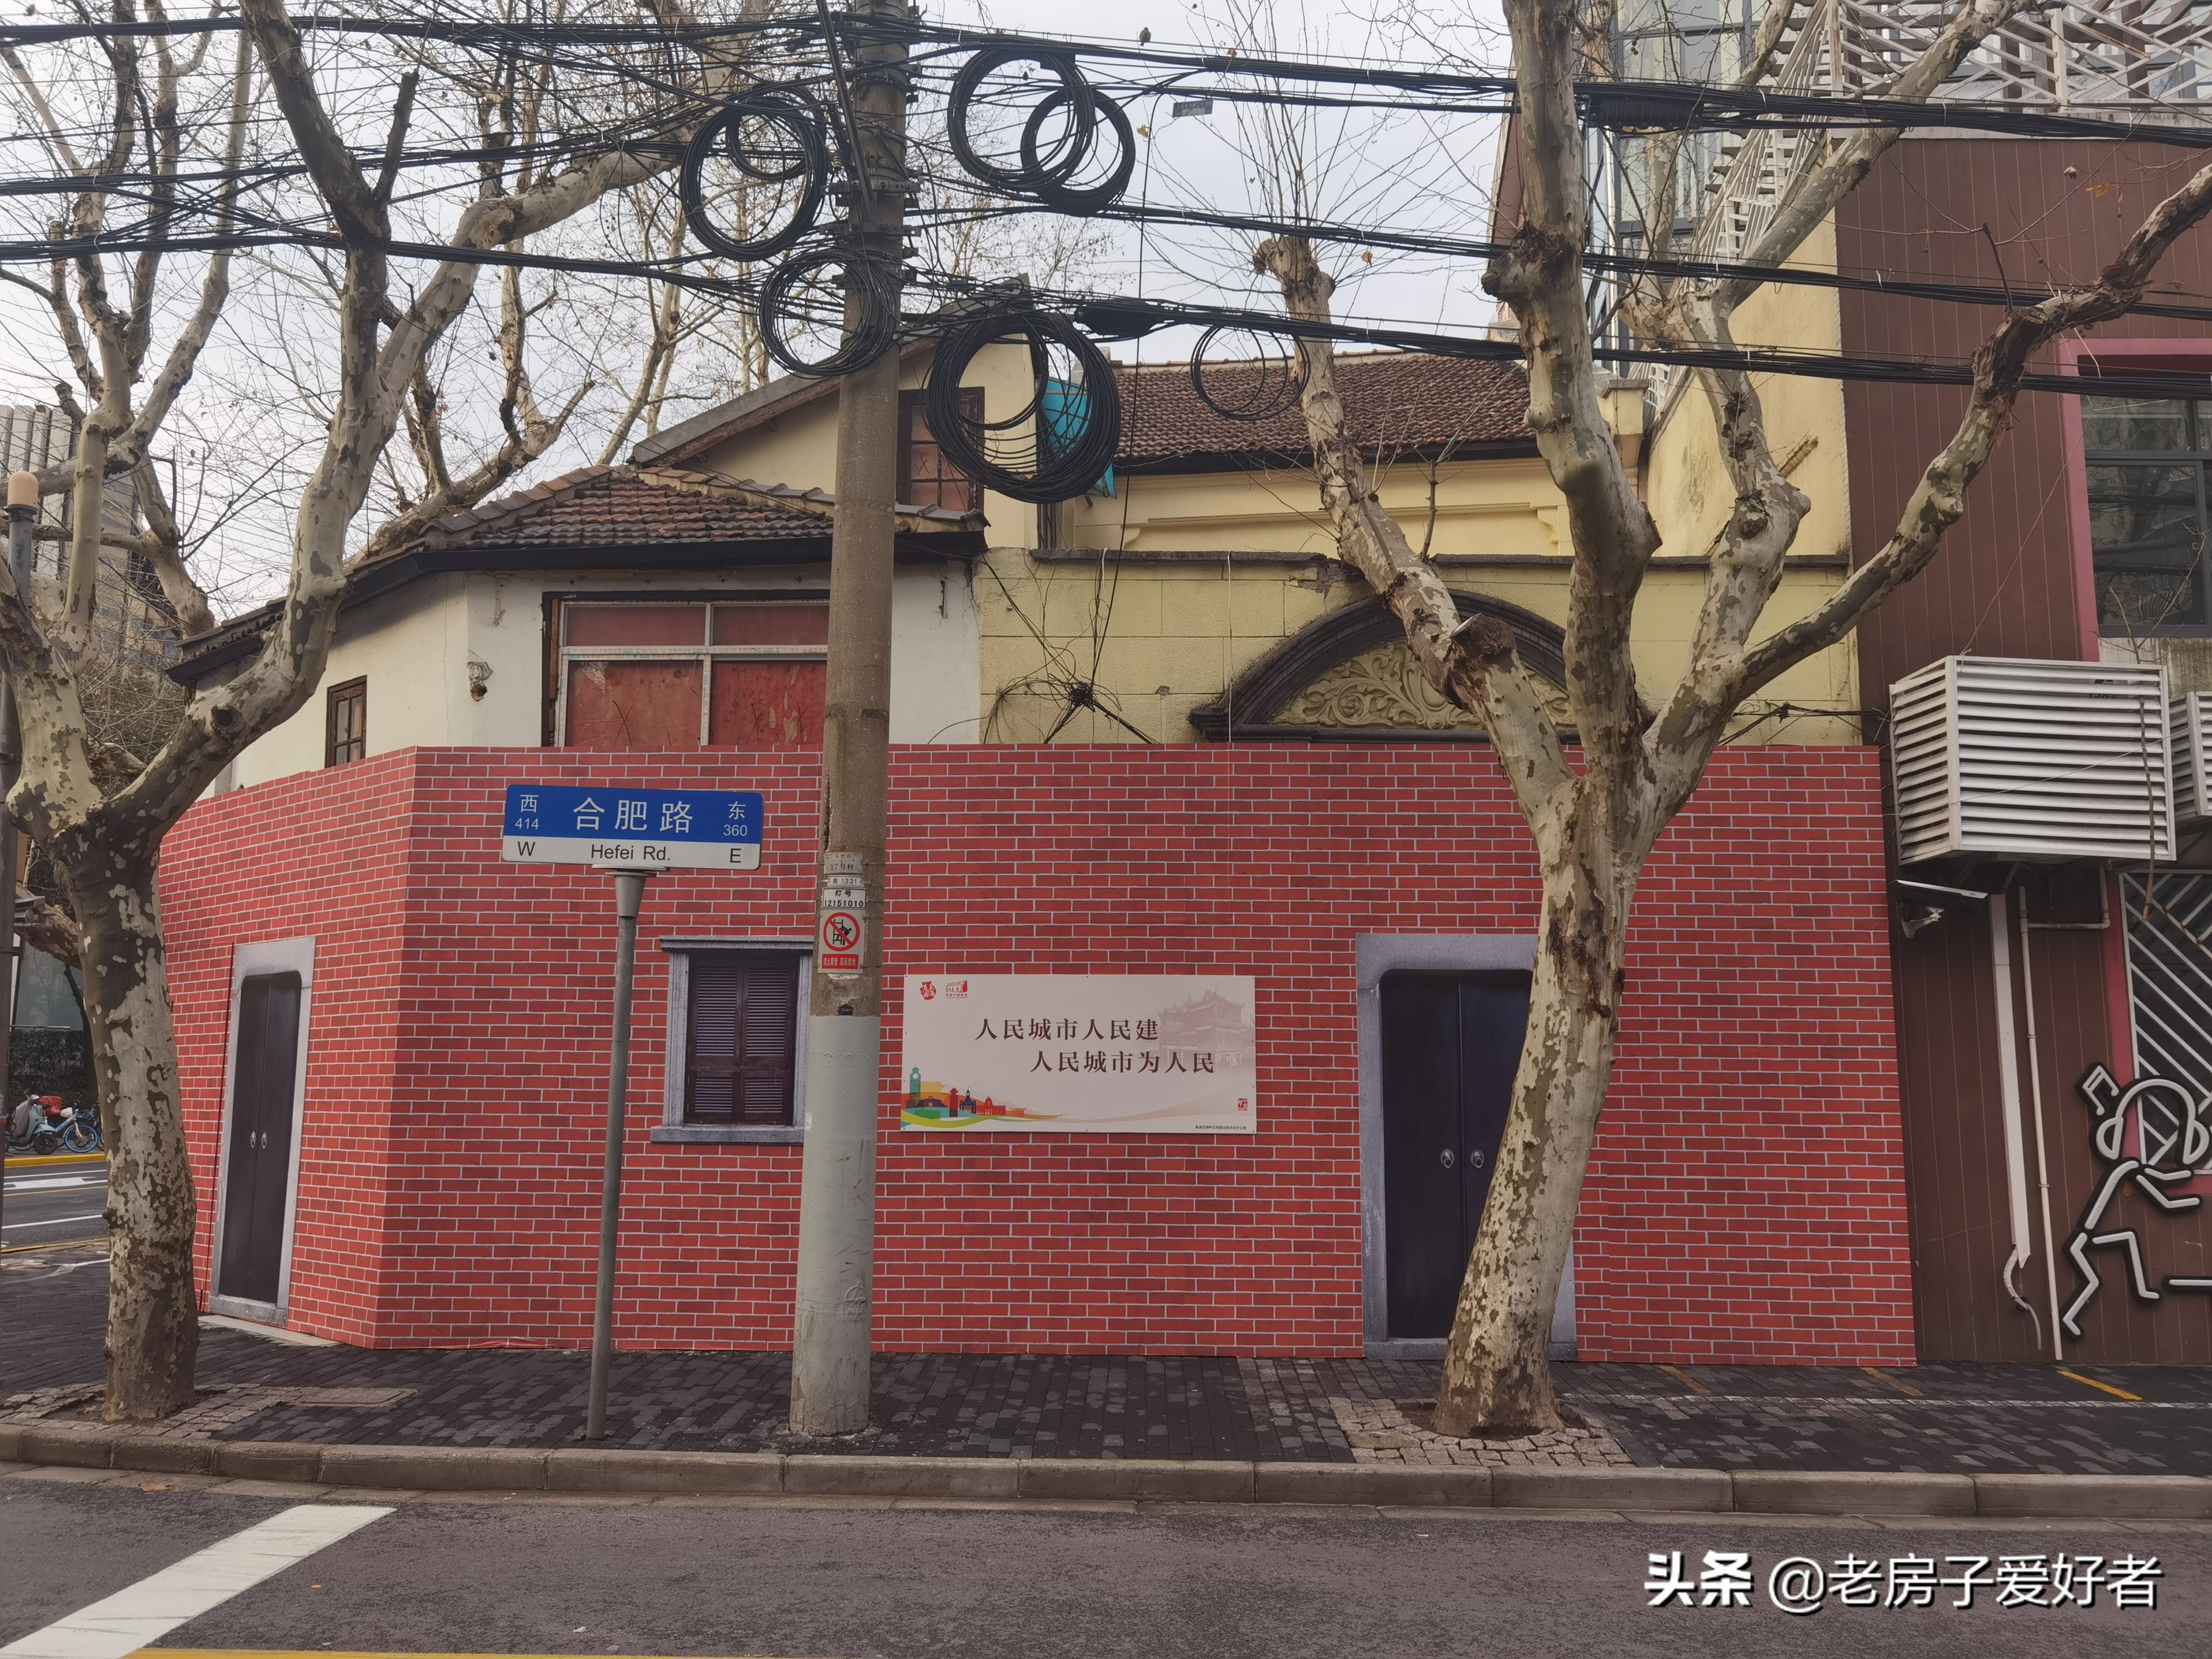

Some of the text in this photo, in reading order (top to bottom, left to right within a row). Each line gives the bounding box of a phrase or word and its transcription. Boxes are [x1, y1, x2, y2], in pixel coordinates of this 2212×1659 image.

[520, 794, 539, 813] 西
[728, 800, 746, 820] 东
[515, 818, 539, 830] 414
[573, 797, 693, 833] 合肥路
[723, 824, 748, 837] 360
[517, 841, 536, 856] W
[591, 844, 671, 861] Hefei Rd.
[730, 848, 741, 862] E
[975, 1017, 1159, 1041] 人民城市人民建
[1029, 1050, 1215, 1074] 人民城市为人民
